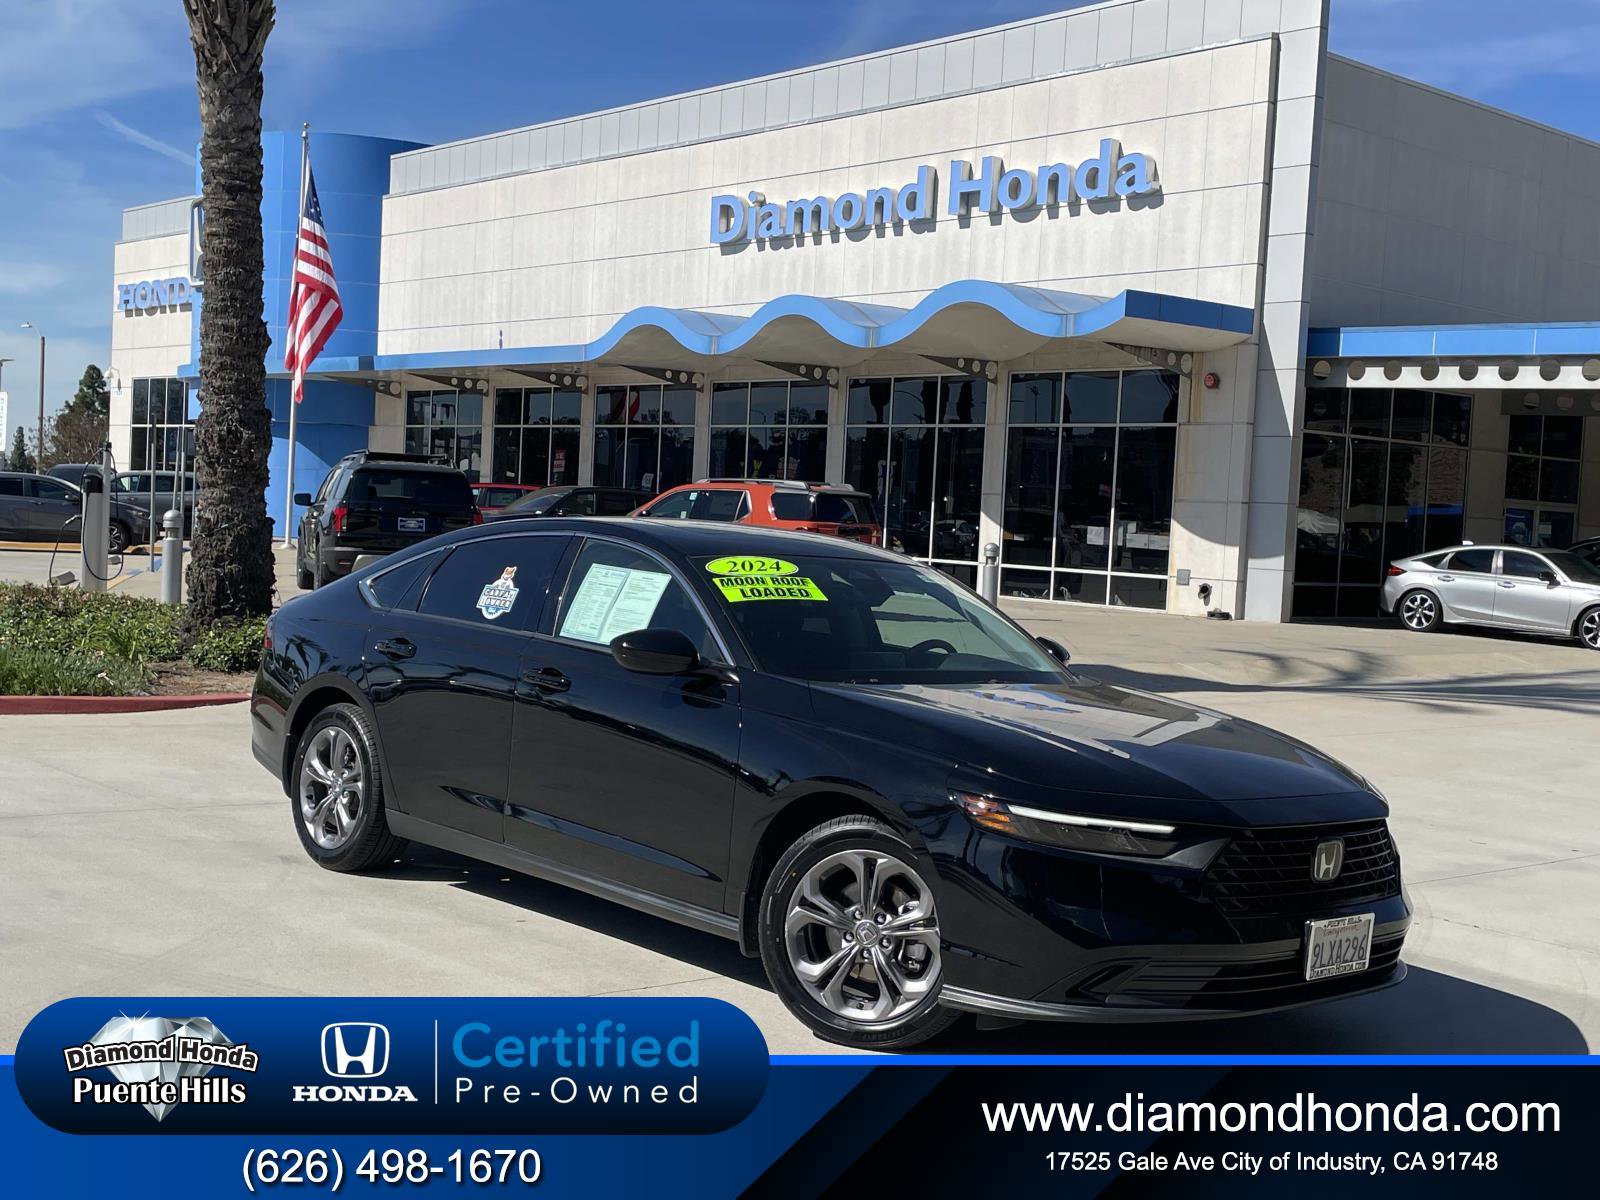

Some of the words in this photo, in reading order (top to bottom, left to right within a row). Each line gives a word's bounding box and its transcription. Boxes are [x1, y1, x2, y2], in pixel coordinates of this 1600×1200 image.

[709, 165, 936, 247] Diamond
[948, 137, 1157, 217] Honda
[117, 277, 192, 310] HOND
[725, 560, 781, 572] 2024
[719, 576, 767, 588] MOON
[770, 576, 809, 586] ROOF
[740, 587, 811, 598] LOADED
[1312, 934, 1368, 969] 9LXA296
